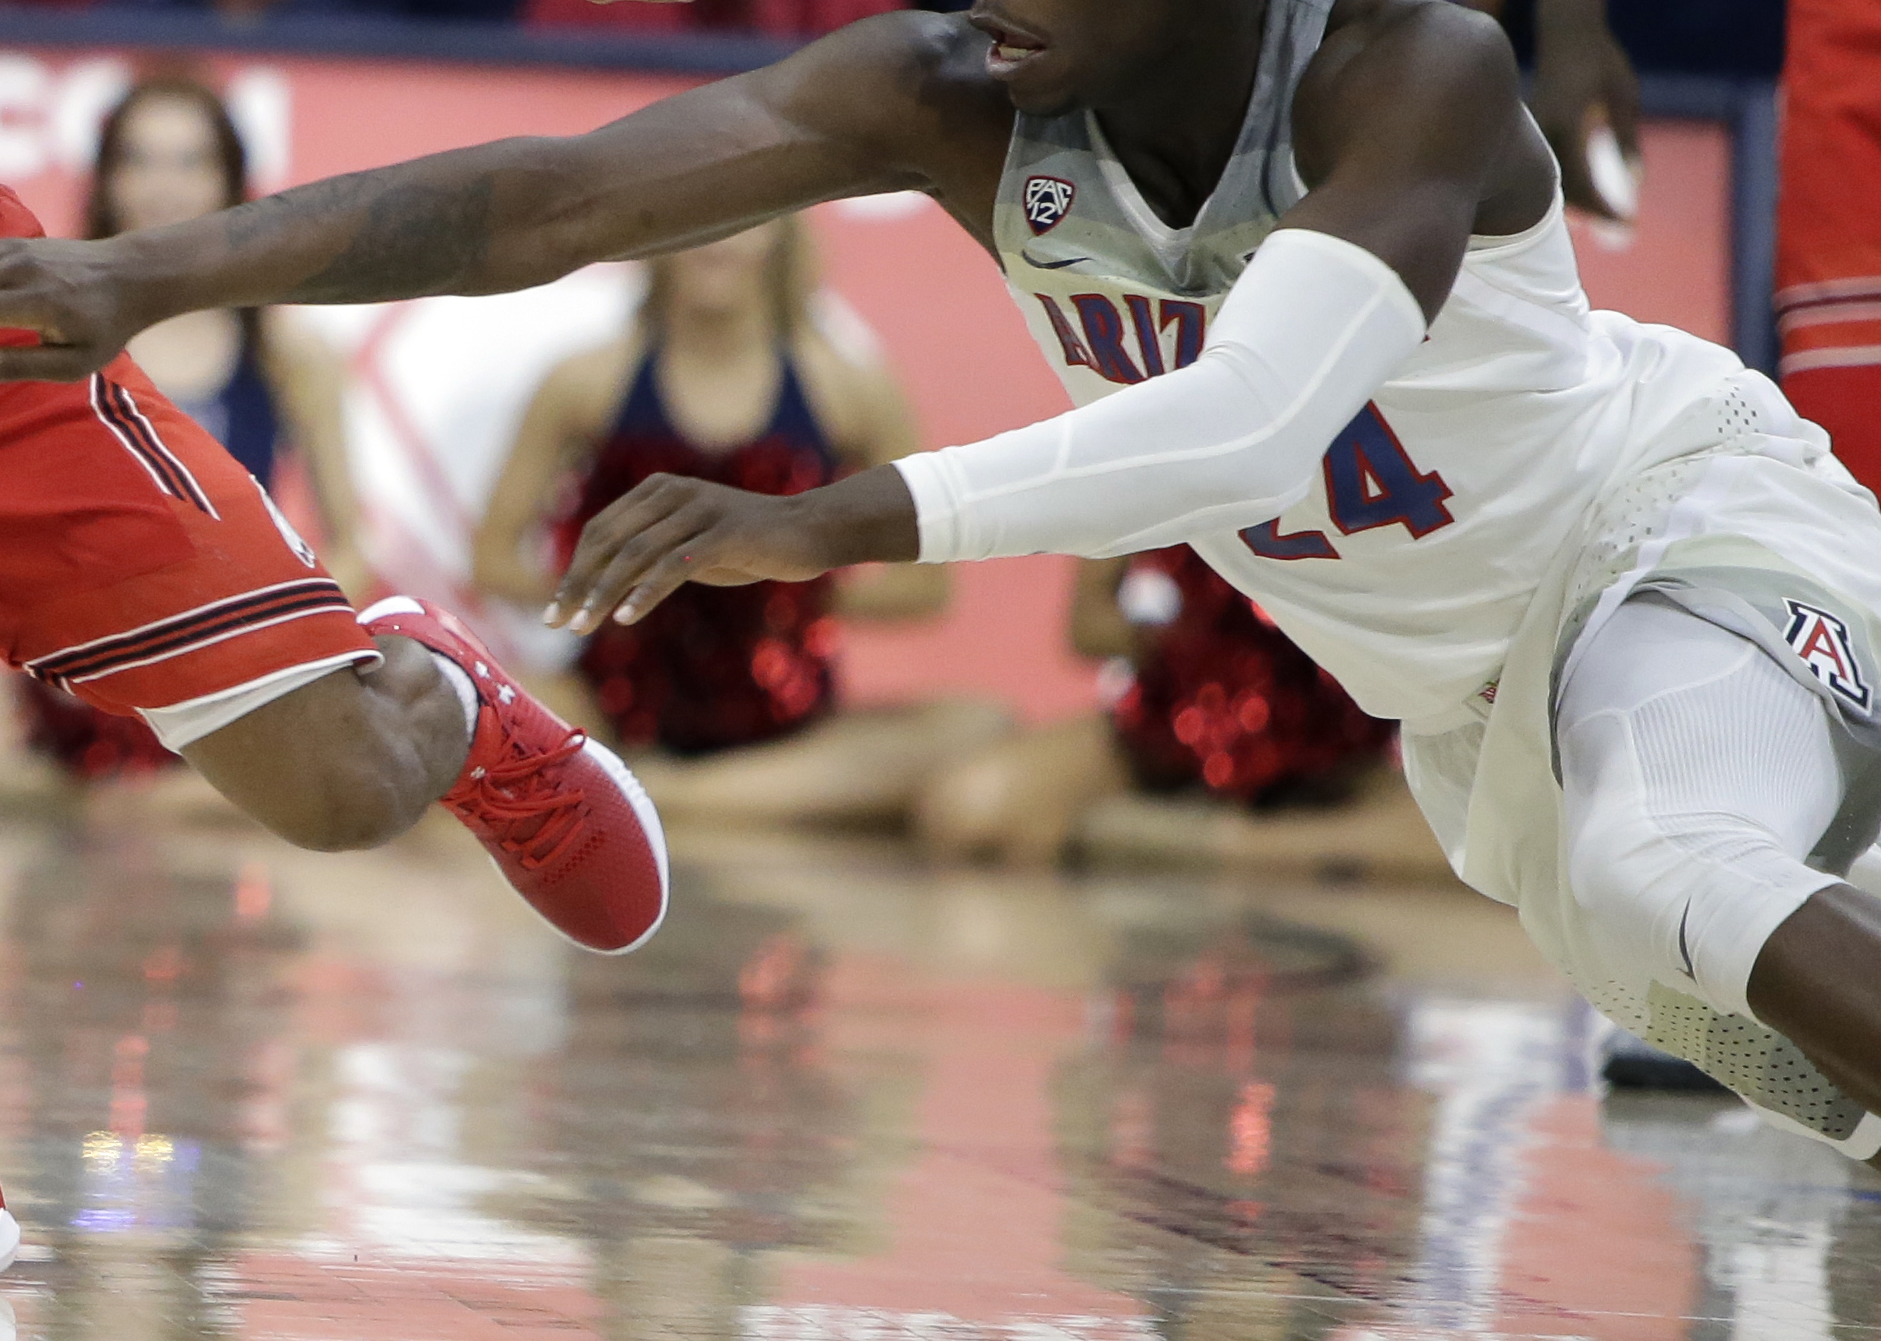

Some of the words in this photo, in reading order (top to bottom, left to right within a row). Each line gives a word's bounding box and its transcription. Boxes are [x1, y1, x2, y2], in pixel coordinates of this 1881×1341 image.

[1026, 179, 1072, 215] PAC
[1029, 201, 1060, 225] 12
[1034, 292, 1208, 385] ARIZ
